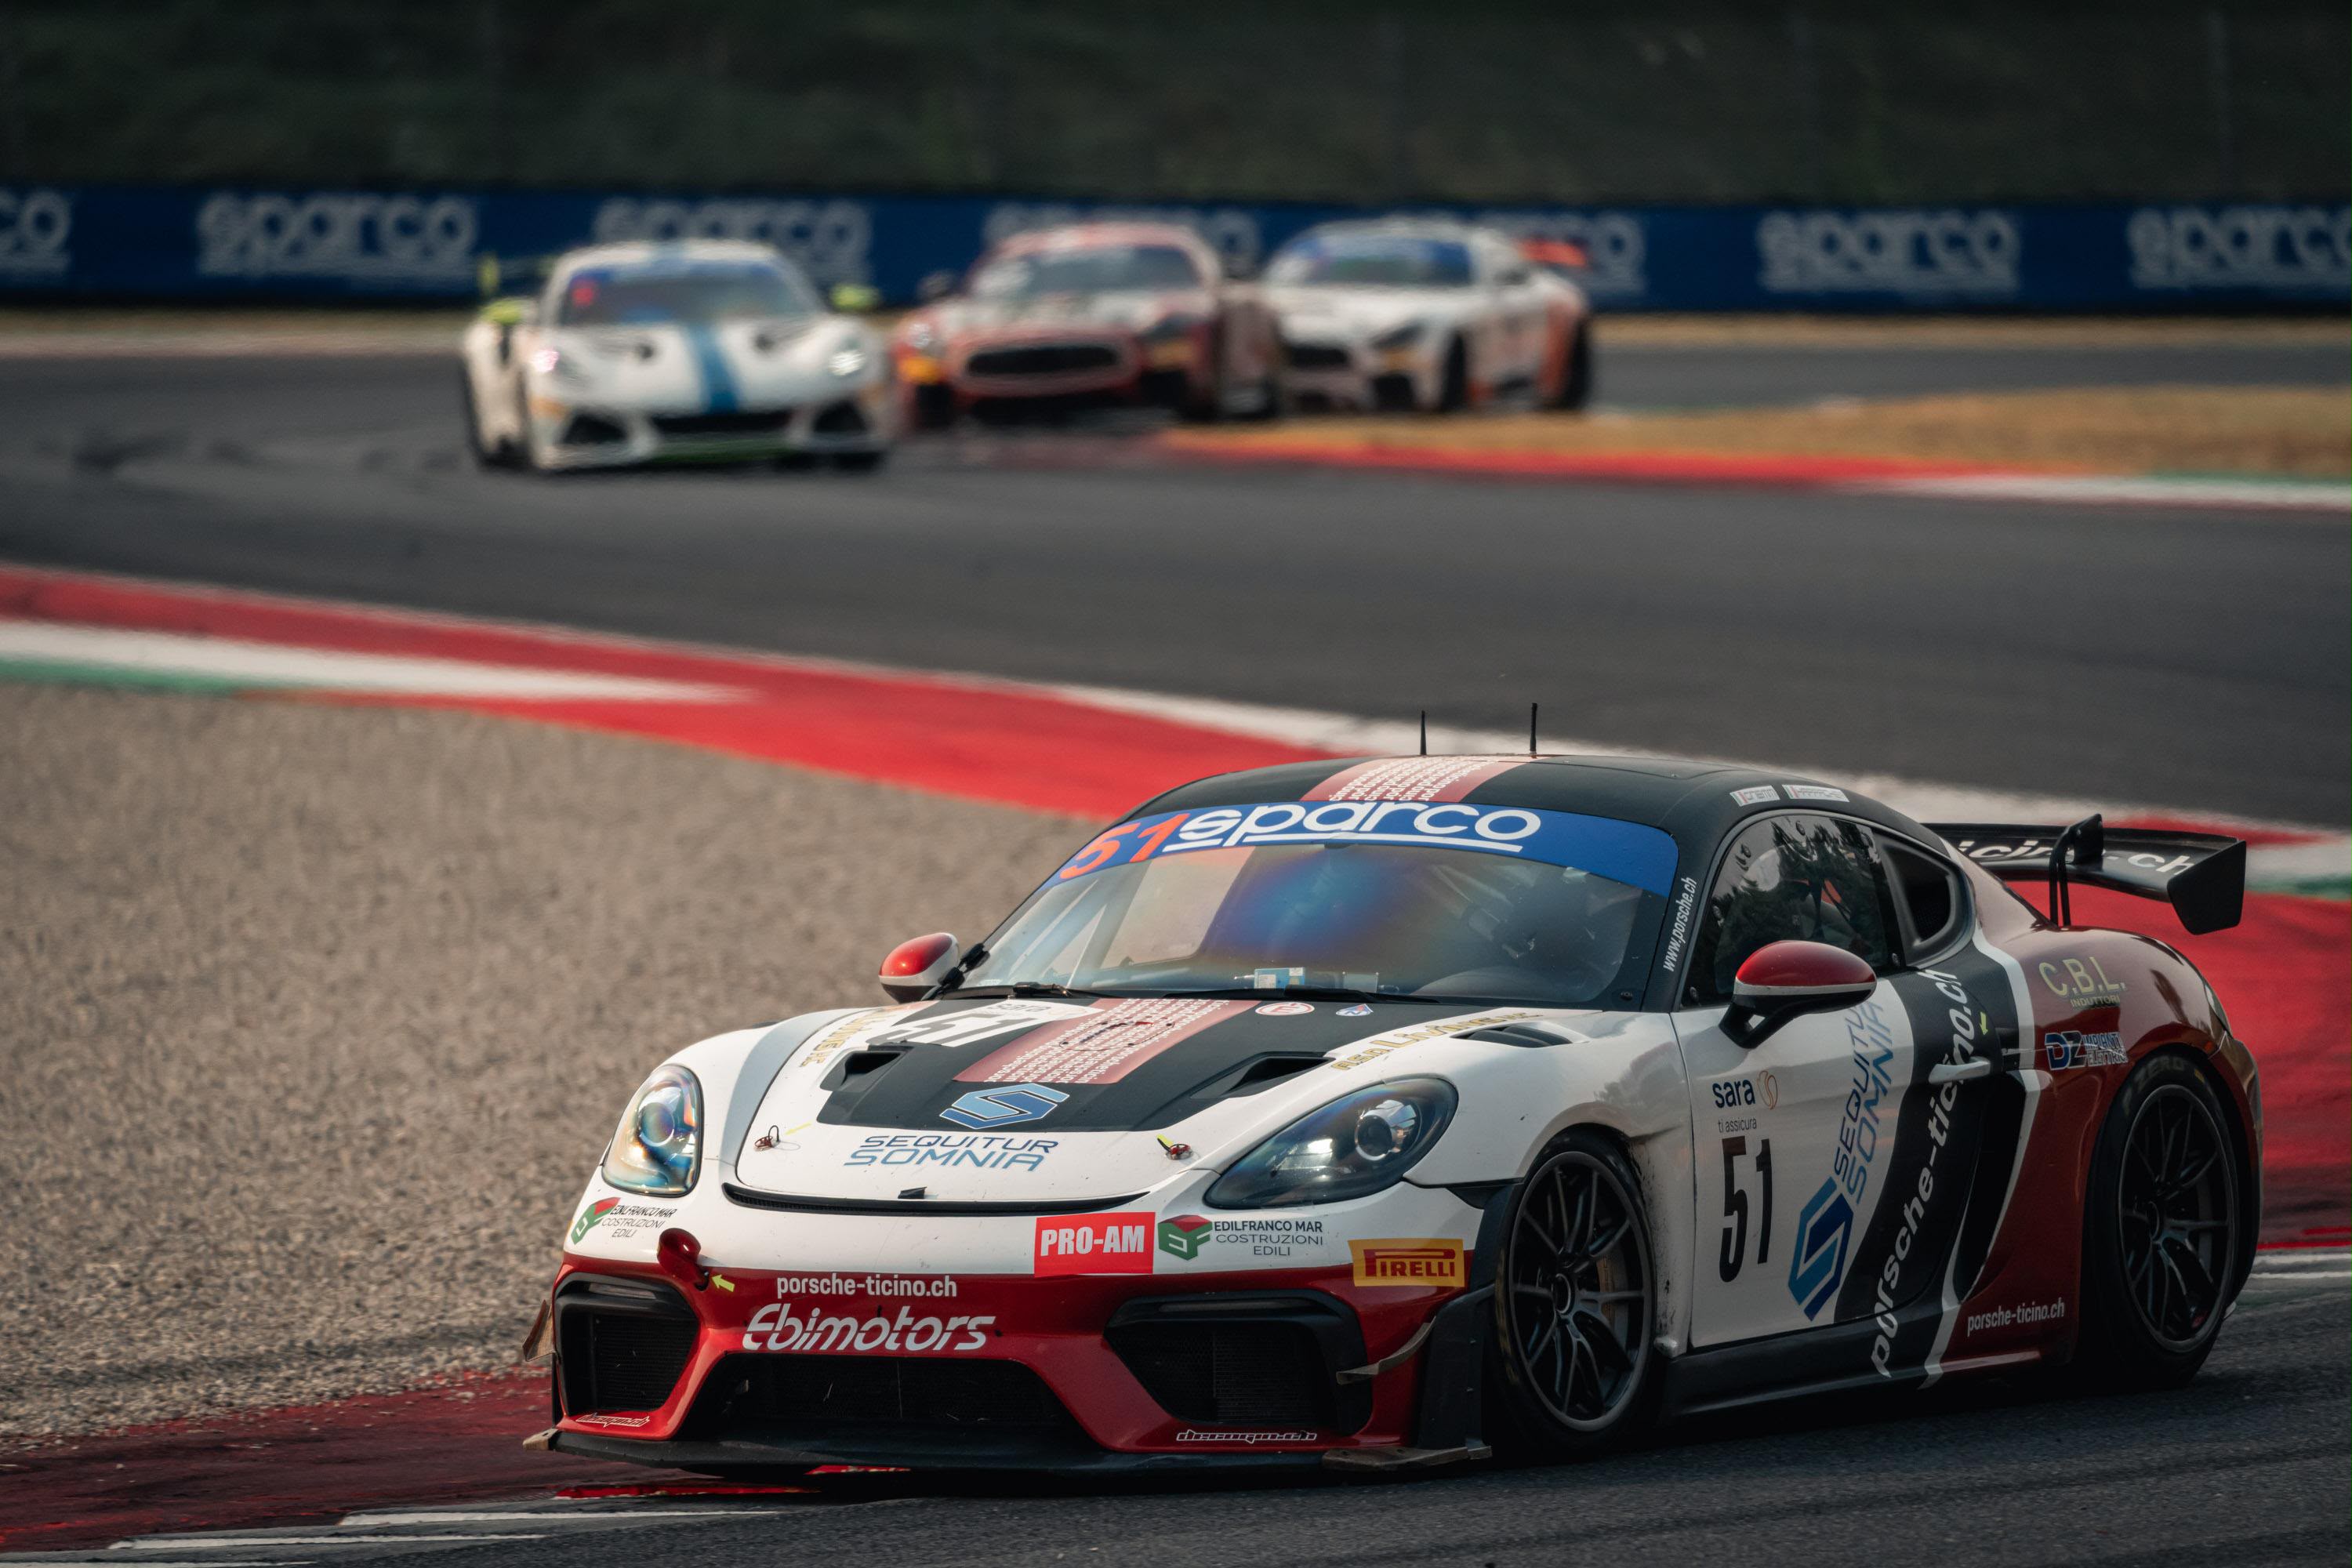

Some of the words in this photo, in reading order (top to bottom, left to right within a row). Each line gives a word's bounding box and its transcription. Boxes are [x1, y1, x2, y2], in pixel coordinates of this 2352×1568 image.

[196, 191, 475, 278] sparco
[1757, 210, 2020, 291] sparco
[1060, 813, 1190, 880] 51
[1163, 801, 1541, 853] sparco
[1663, 877, 1697, 972] www.porsche.ch
[2038, 956, 2127, 996] C.B.L.
[2071, 995, 2120, 1007] INDUTTORI
[1711, 1079, 1755, 1109] sara
[1834, 1007, 1870, 1182] SEQUITU
[1845, 1002, 1894, 1205] SOMNIA
[1725, 1116, 1757, 1132] assicura
[860, 1135, 1059, 1153] SEQUITUR
[844, 1148, 1045, 1172] SOMNIA
[601, 1218, 665, 1229] COSTRUZIONI
[1719, 1135, 1773, 1283] 51
[612, 1228, 637, 1237] EDILI
[1040, 1225, 1145, 1256] PRO-AM
[1214, 1220, 1292, 1232] EDILFRANCO
[1294, 1221, 1323, 1233] MAR
[1215, 1233, 1323, 1245] COSTRUZIONI
[1253, 1245, 1291, 1256] EDILI
[1363, 1248, 1456, 1278] PIRELLI
[776, 1272, 957, 1299] porsche-ticino.ch
[742, 1303, 996, 1352] Ebimotors
[1966, 1297, 2066, 1338] porsche-ticino.ch
